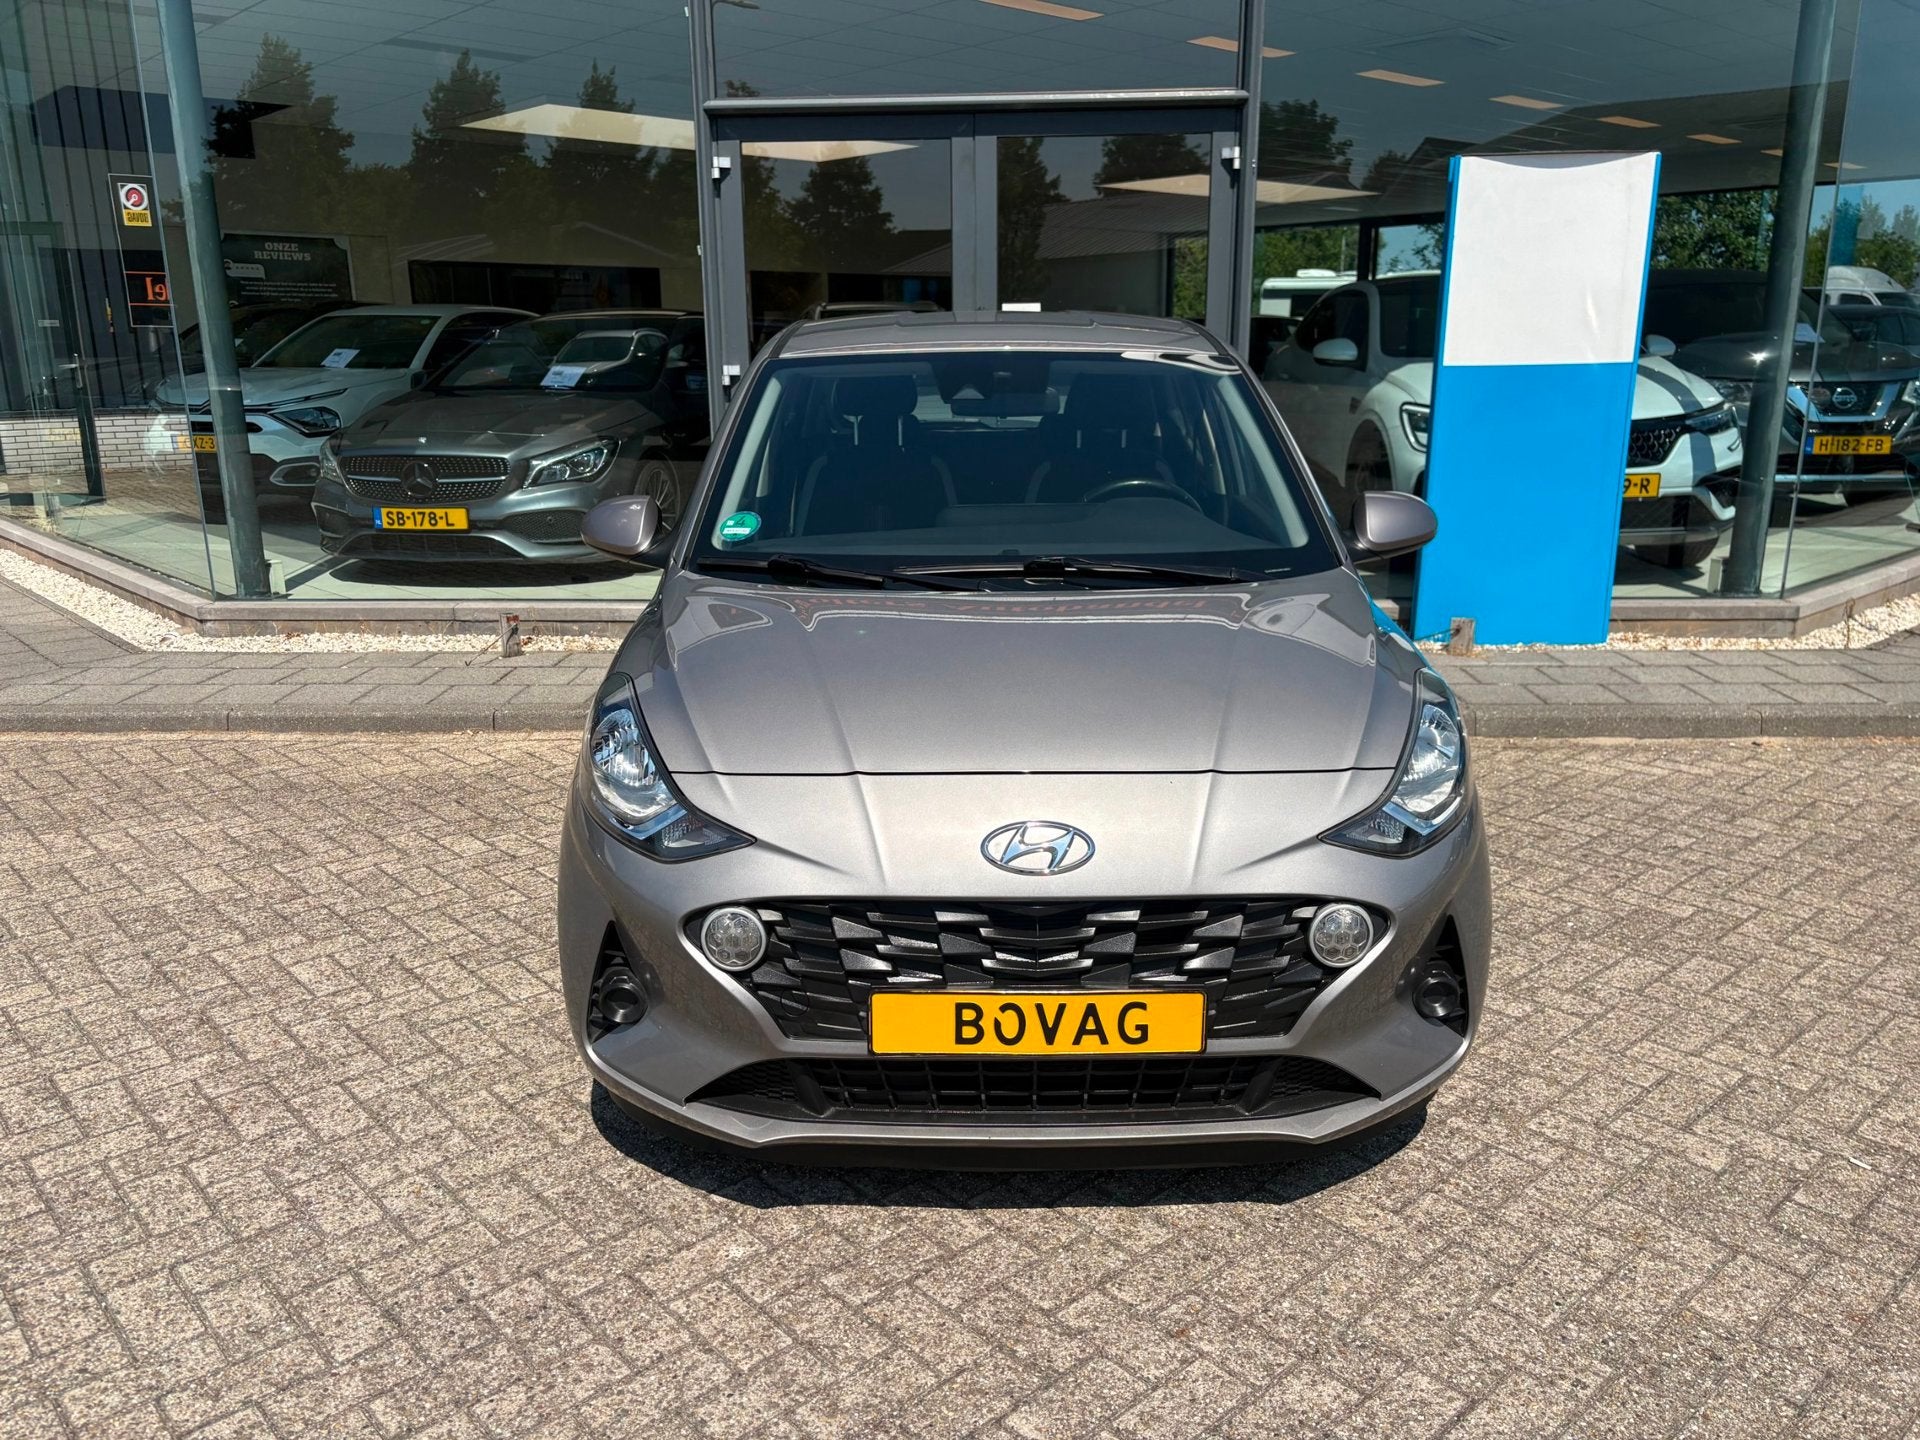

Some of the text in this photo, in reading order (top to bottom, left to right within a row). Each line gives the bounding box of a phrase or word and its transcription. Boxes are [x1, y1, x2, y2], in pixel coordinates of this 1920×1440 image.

[264, 242, 299, 251] ONZE
[254, 251, 312, 260] REVIEWS
[386, 511, 455, 527] SB-178-L
[954, 1001, 1149, 1046] BOVAG
